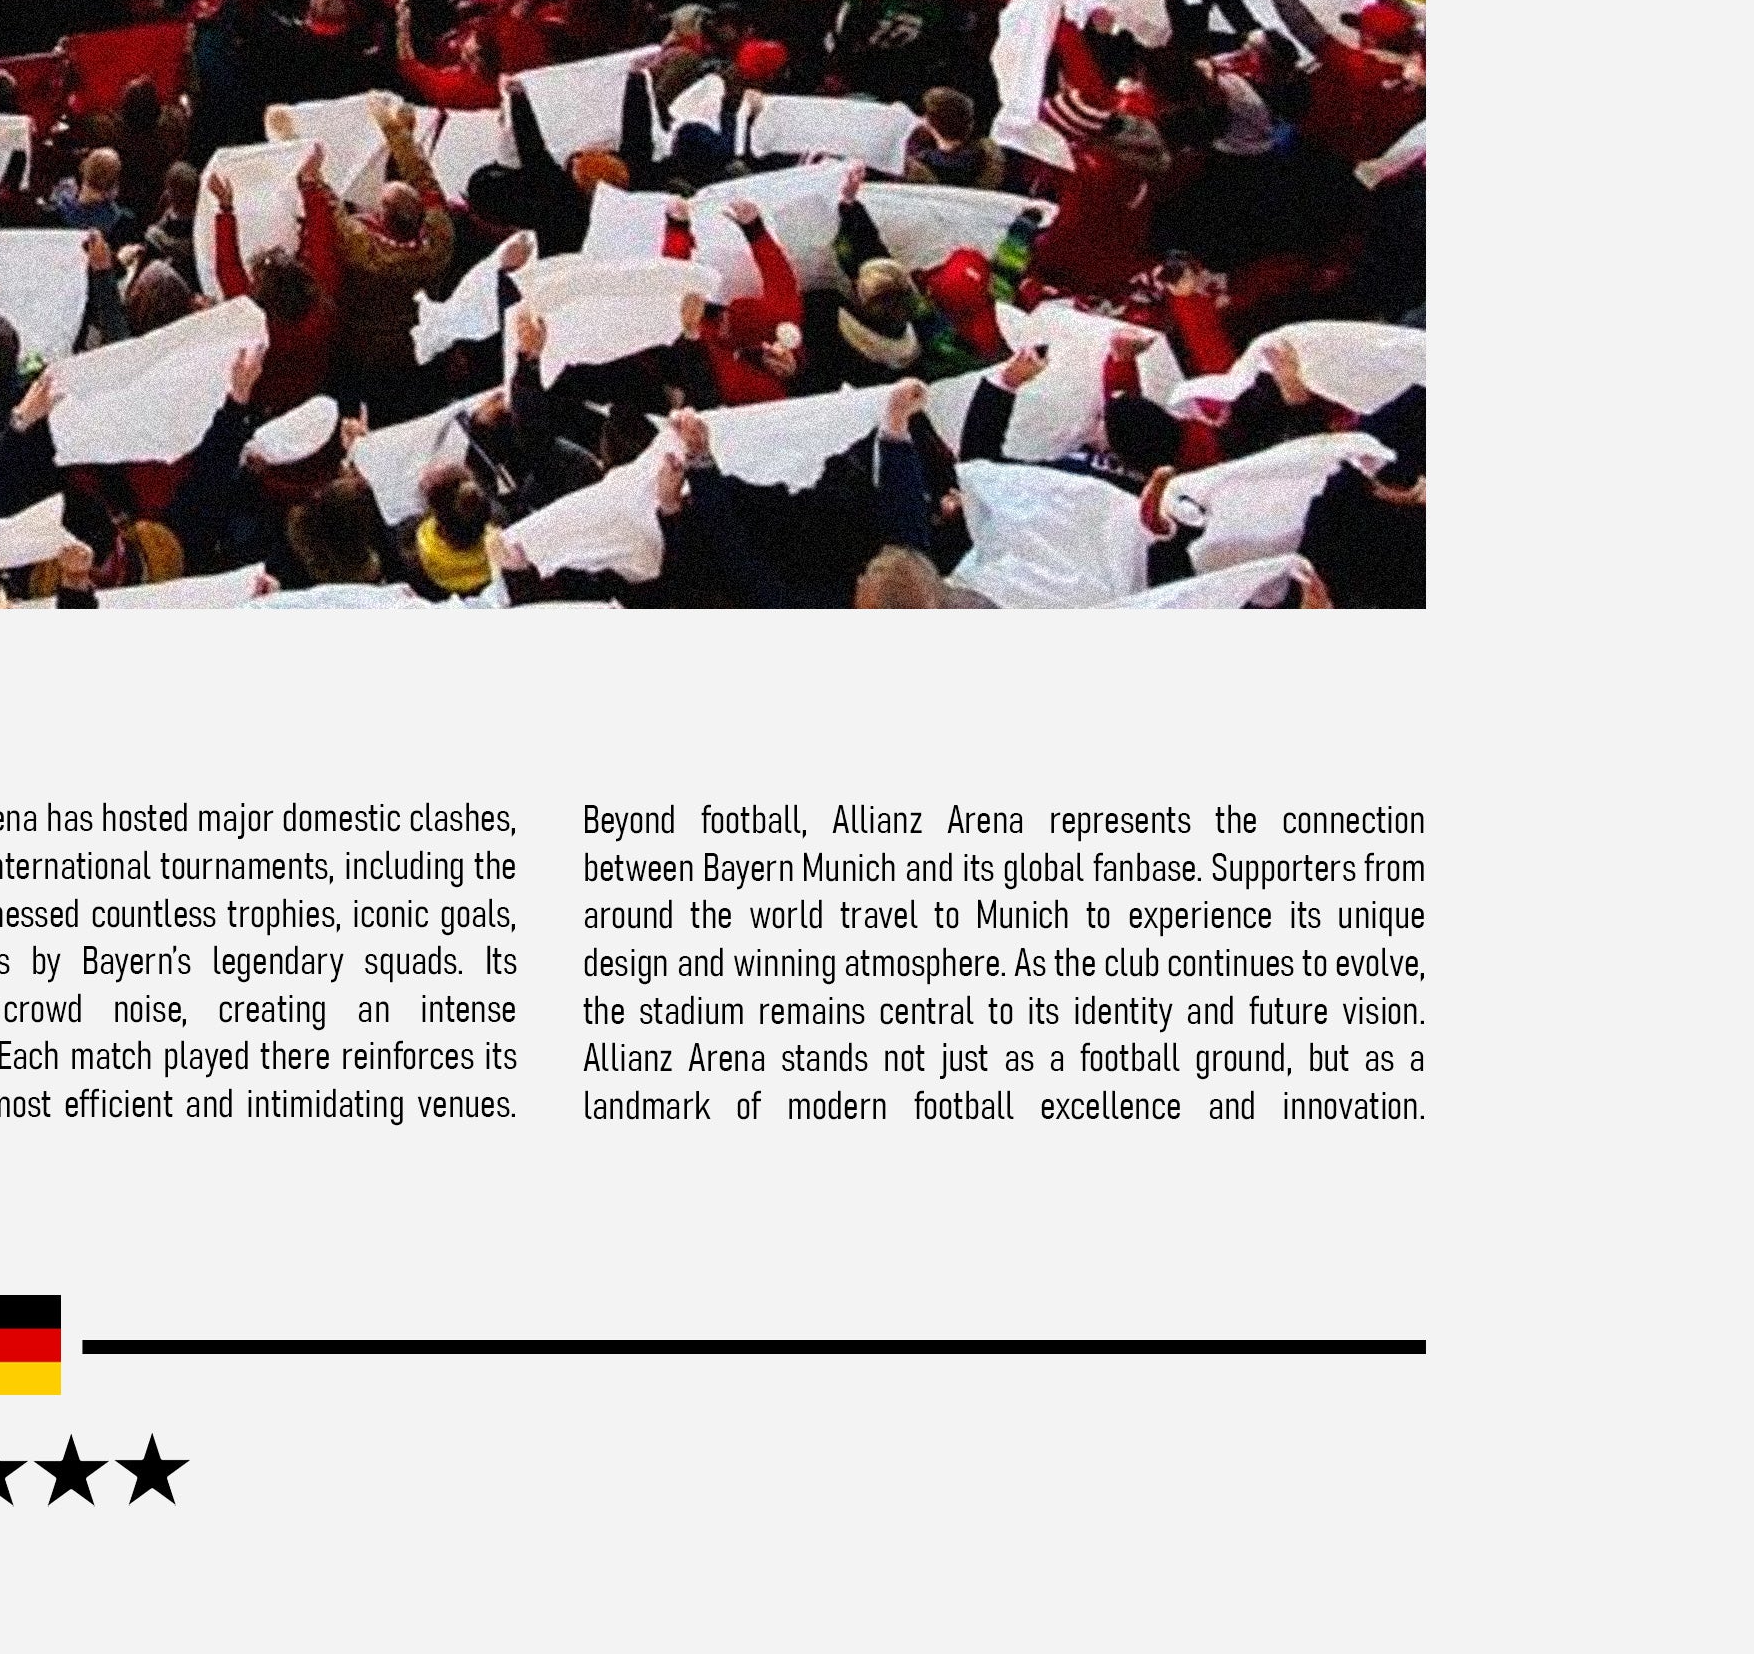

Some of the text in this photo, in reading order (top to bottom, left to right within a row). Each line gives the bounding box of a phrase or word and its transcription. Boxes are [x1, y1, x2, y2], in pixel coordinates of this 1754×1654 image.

[47, 802, 93, 832] has
[102, 802, 188, 832] hosted
[198, 802, 274, 840] major
[283, 802, 401, 832] domestic
[410, 802, 516, 837] clashes,
[584, 804, 1424, 842] Beyond football, Allianz Arena represents the connection
[160, 852, 334, 885] tournaments,
[346, 850, 464, 888] including
[474, 850, 516, 880] the
[584, 852, 1425, 890] between Bayern Munich and its global fanbase. Supporters from
[92, 898, 216, 928] countless
[227, 898, 341, 936] trophies,
[354, 899, 429, 928] iconic
[441, 898, 516, 936] goals,
[584, 947, 1425, 985] design and winning atmosphere. As the club continues to evolve,
[4, 993, 82, 1023] crowd
[114, 994, 187, 1028] noise,
[219, 994, 326, 1031] creating
[358, 1000, 389, 1023] an
[422, 994, 516, 1023] intense
[71, 1040, 151, 1070] match
[164, 1040, 249, 1078] played
[260, 1040, 330, 1070] there
[342, 1040, 474, 1070] reinforces
[486, 1041, 517, 1070] its
[583, 1042, 1424, 1080] Allianz Arena stands not just as a football ground, but as a
[584, 1090, 1425, 1120] landmark of modern football excellence and innovation.
